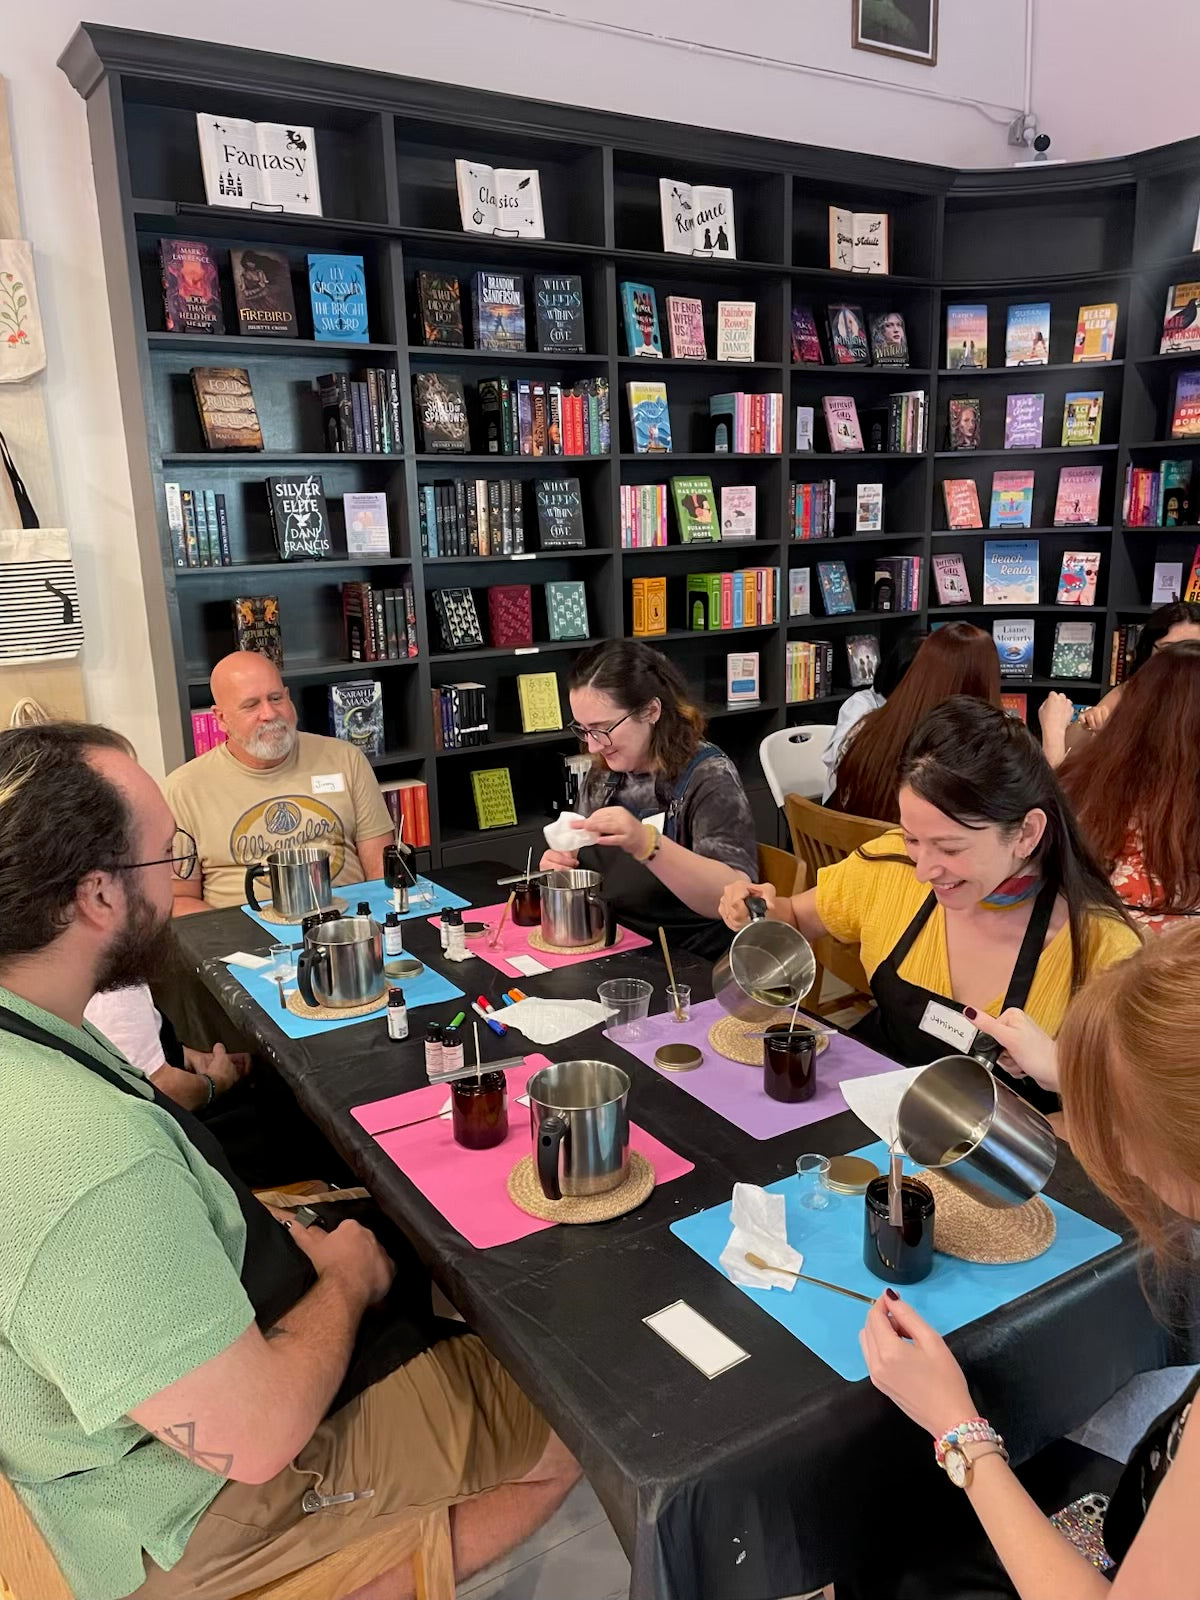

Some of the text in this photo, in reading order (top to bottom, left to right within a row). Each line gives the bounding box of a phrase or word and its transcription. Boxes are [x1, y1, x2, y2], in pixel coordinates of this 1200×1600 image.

[224, 144, 306, 177] Fantasy
[487, 277, 515, 291] BRANDON
[543, 279, 572, 291] WHAT
[482, 289, 521, 305] SANDERSON
[239, 307, 294, 322] FIREBIRD
[331, 302, 365, 317] BRIGHT
[672, 300, 702, 315] IT ENDS
[673, 313, 694, 326] WITH
[674, 324, 686, 337] US
[208, 379, 242, 394] FOUR
[206, 394, 252, 409] RUINED
[426, 400, 456, 413] SHIELD
[424, 410, 466, 424] SPARROWS
[275, 482, 322, 497] SILVER
[542, 481, 570, 493] WHAT
[283, 499, 319, 513] ELITE
[290, 528, 320, 540] DANI
[284, 538, 330, 552] FRANCIS
[991, 553, 1024, 564] Beach
[1000, 564, 1033, 576] Reads
[1003, 625, 1027, 635] Liane
[346, 697, 370, 706] MAAS
[237, 818, 336, 863] Wrangler
